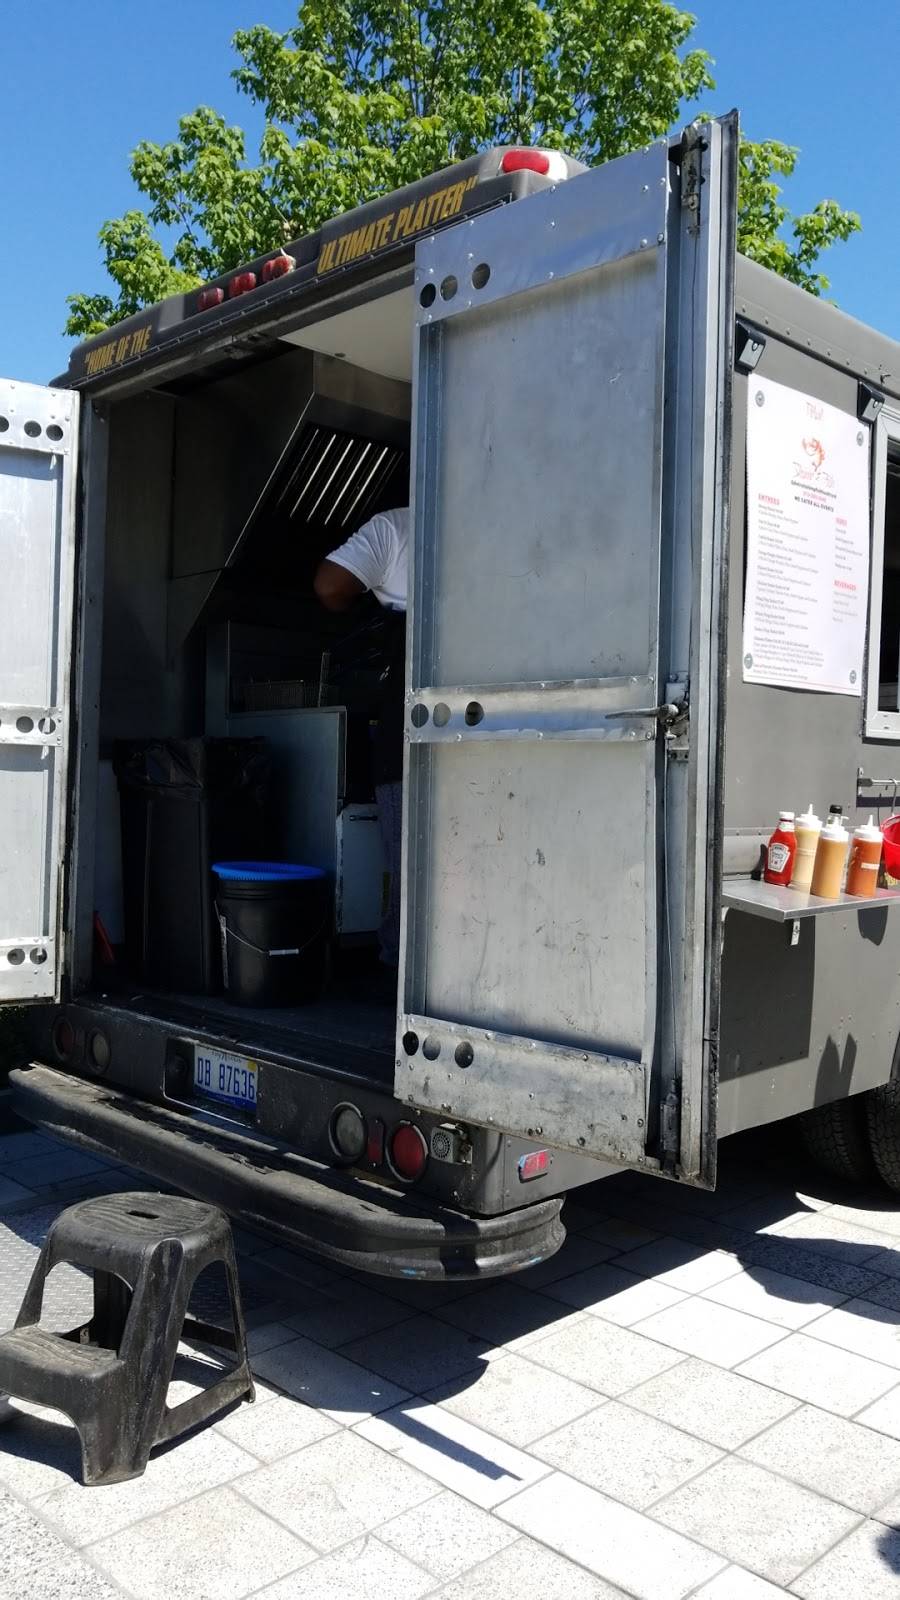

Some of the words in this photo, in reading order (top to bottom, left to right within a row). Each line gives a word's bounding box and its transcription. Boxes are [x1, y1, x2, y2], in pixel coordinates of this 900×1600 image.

[115, 335, 131, 362] OF
[317, 213, 395, 274] ULTIMATE
[393, 175, 479, 241] PLATTER"
[198, 1056, 211, 1087] DB
[219, 1063, 255, 1100] 87636
